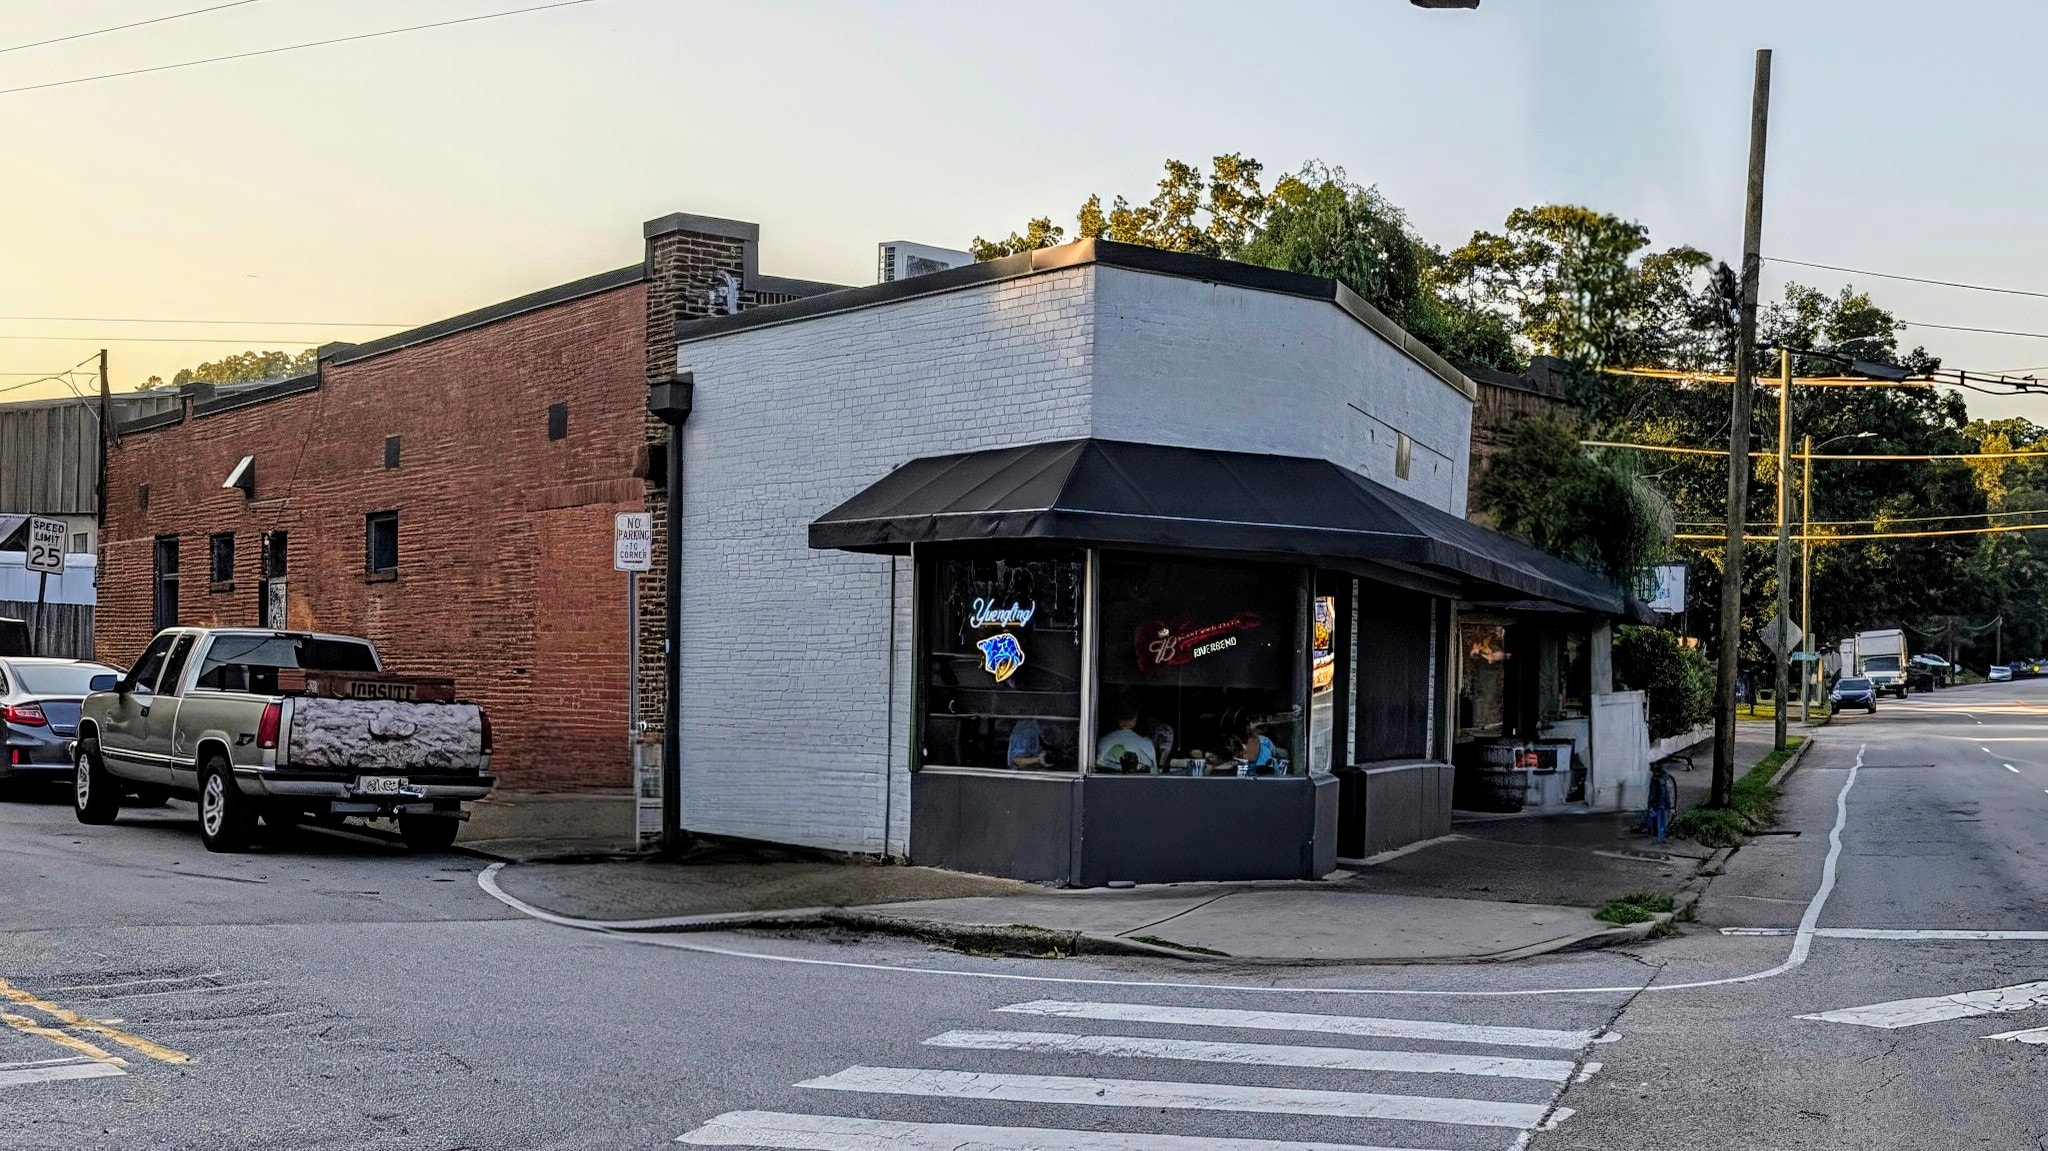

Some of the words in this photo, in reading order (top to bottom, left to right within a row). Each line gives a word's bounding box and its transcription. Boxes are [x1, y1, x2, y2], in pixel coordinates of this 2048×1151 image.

[34, 520, 64, 533] SPEED
[627, 518, 640, 528] NO
[35, 531, 60, 543] LIMIT
[619, 530, 649, 540] PARKING
[31, 546, 60, 567] 25
[620, 551, 647, 559] CORNER
[970, 597, 1035, 628] Yuengling
[1193, 636, 1237, 658] RIVERBEND
